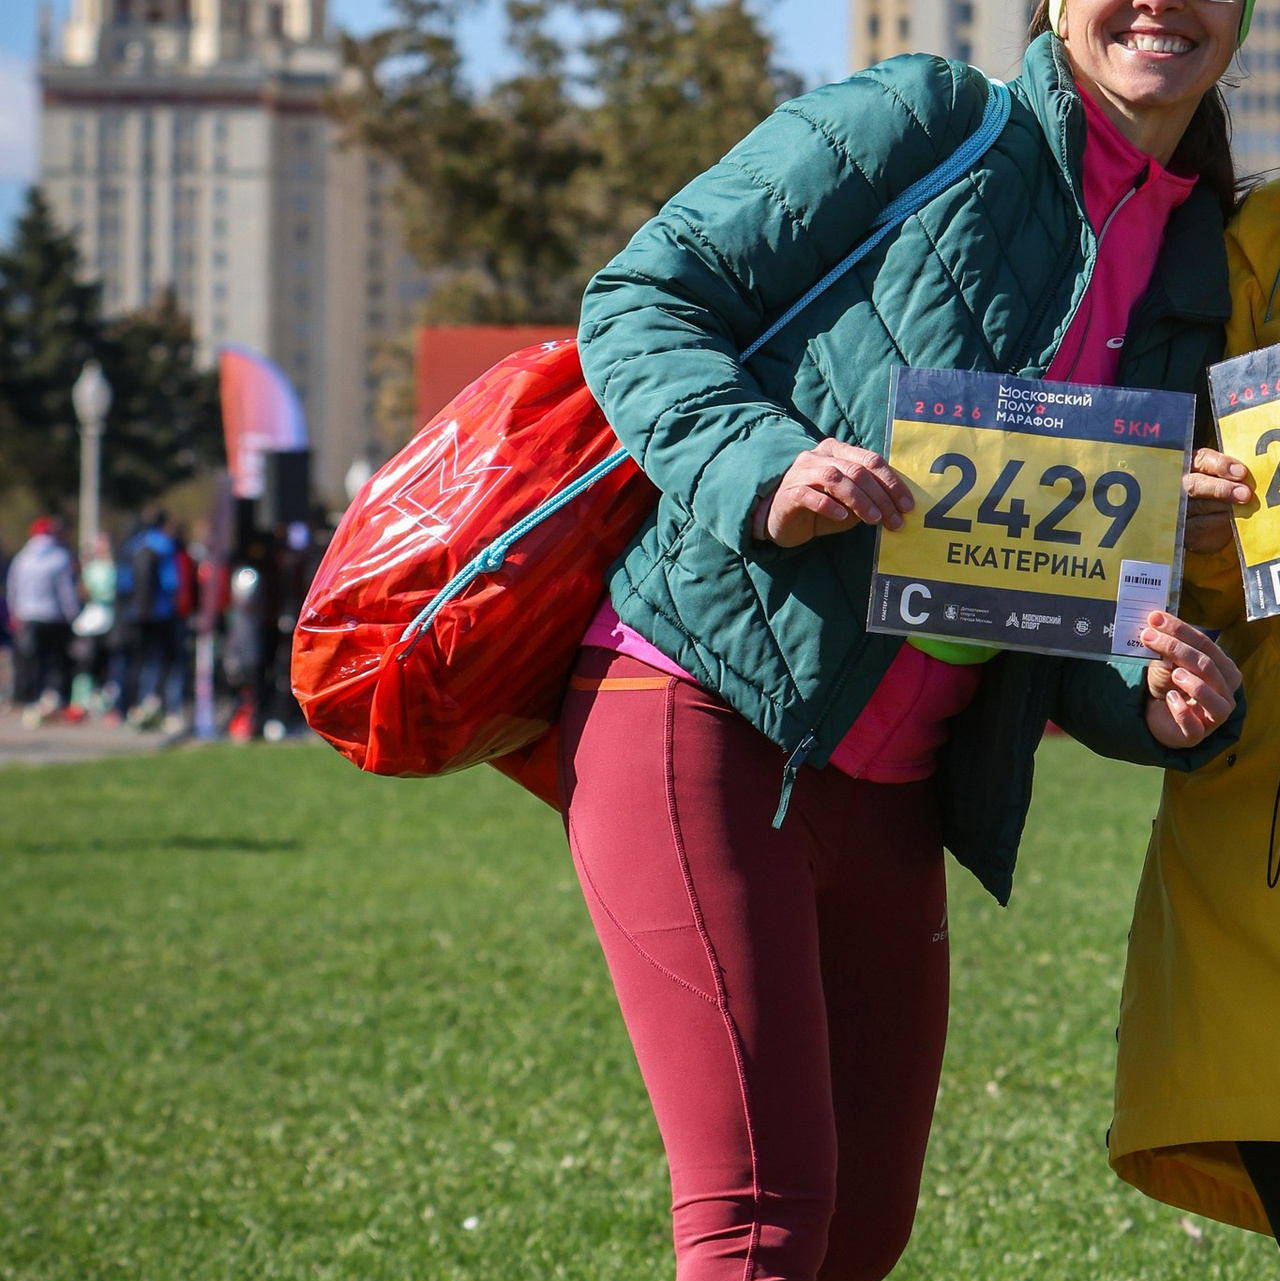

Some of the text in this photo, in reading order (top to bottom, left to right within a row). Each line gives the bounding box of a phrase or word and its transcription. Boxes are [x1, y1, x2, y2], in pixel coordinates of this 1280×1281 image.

[997, 398, 1035, 413] ПОЛУ
[998, 384, 1093, 407] МОСКОВСКИЙ
[996, 410, 1064, 429] МАРАФОН
[923, 452, 1142, 549] 2429
[946, 542, 1107, 581] ЕКАТЕРИНА
[899, 583, 932, 625] C
[1021, 613, 1062, 625] МОСКОВСКИЙ
[1021, 621, 1040, 630] СПОРТ
